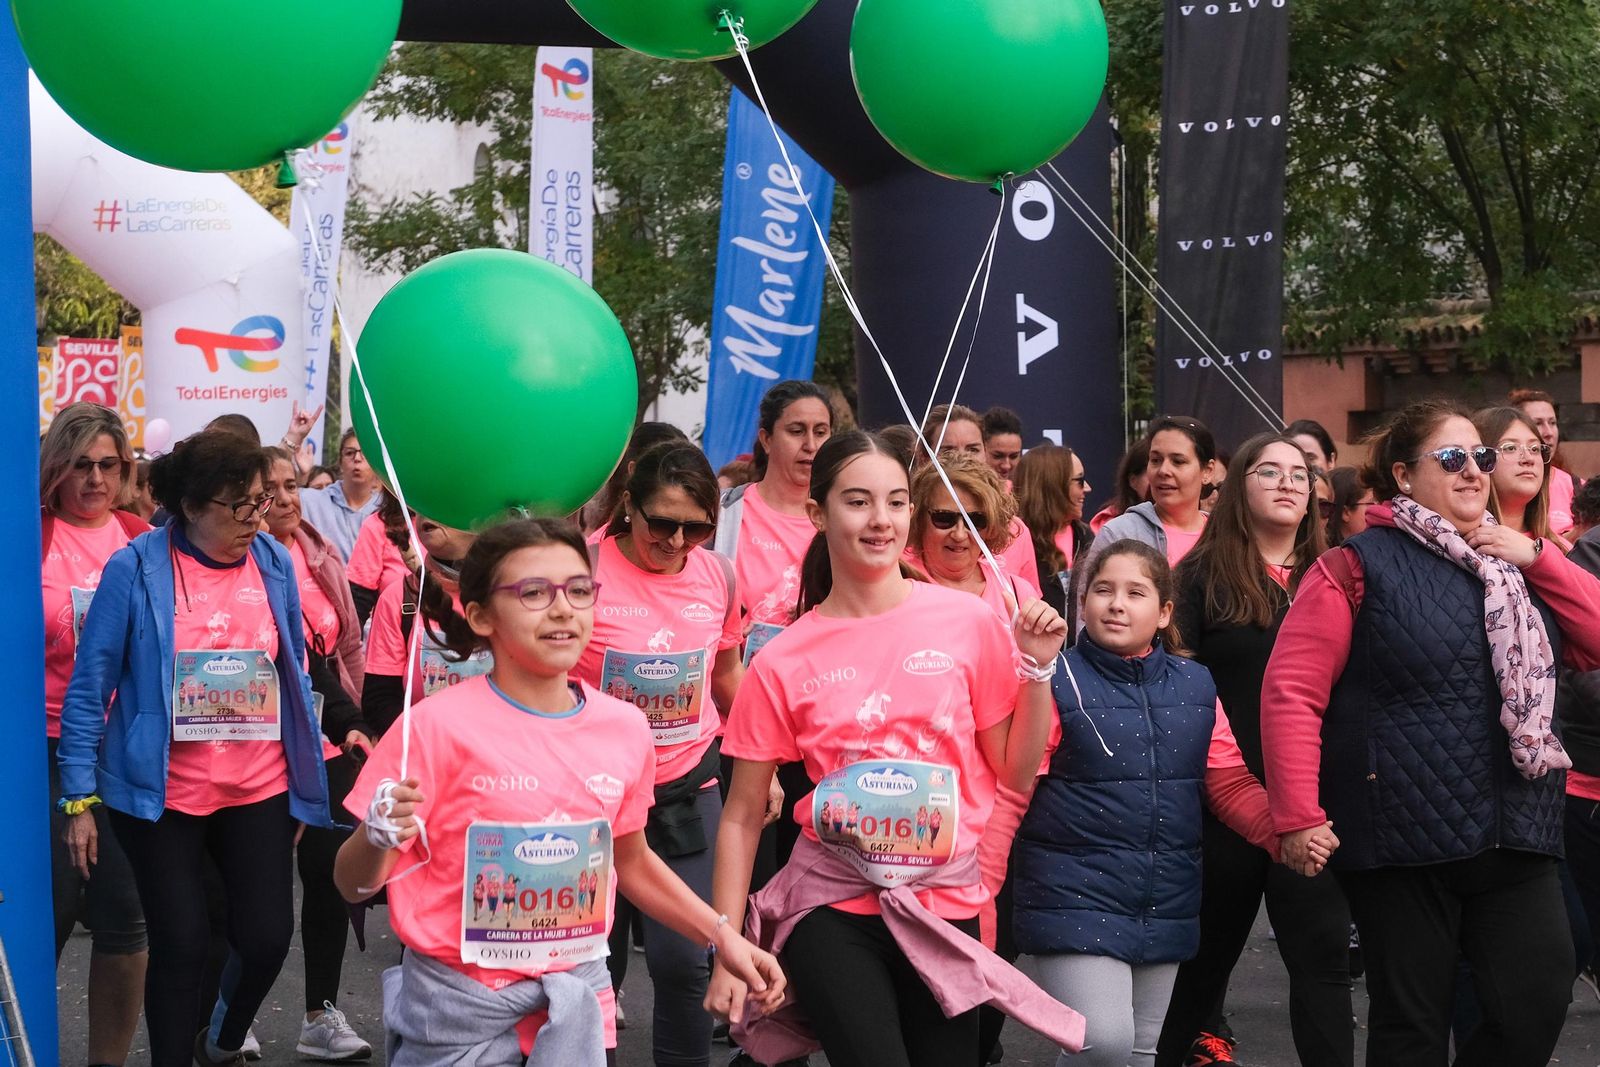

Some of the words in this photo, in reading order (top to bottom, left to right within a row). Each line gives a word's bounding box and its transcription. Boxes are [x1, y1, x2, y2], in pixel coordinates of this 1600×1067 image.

[1179, 0, 1286, 16] VOLVO
[1178, 114, 1282, 135] VOLVO
[1177, 231, 1273, 252] VOLVO
[722, 163, 815, 380] Marlene
[64, 342, 120, 356] SEVILLA
[1175, 349, 1272, 369] VOLVO
[176, 384, 288, 403] TotalEnergies
[602, 606, 648, 618] OYSHO
[206, 664, 245, 672] ASTURIANA
[636, 666, 677, 676] ASTURIANA
[803, 667, 857, 694] OYSHO
[207, 689, 246, 704] 016
[635, 694, 675, 709] 016
[185, 727, 218, 736] OYSHO
[472, 775, 539, 791] OYSHO
[861, 776, 914, 791] ASTURIANA
[860, 815, 912, 838] 016
[518, 845, 576, 858] ASTURIANA
[870, 842, 895, 852] 6427
[871, 854, 880, 862] LA
[881, 854, 903, 863] MUJER
[907, 856, 933, 865] SEVILLA
[519, 887, 574, 912] 016
[531, 917, 558, 929] 6424
[486, 930, 521, 940] CARRERA
[522, 931, 532, 940] DE
[533, 931, 543, 940] LA
[544, 929, 567, 939] MUJER
[571, 925, 593, 937] SEVILLA
[480, 948, 531, 959] OYSHO
